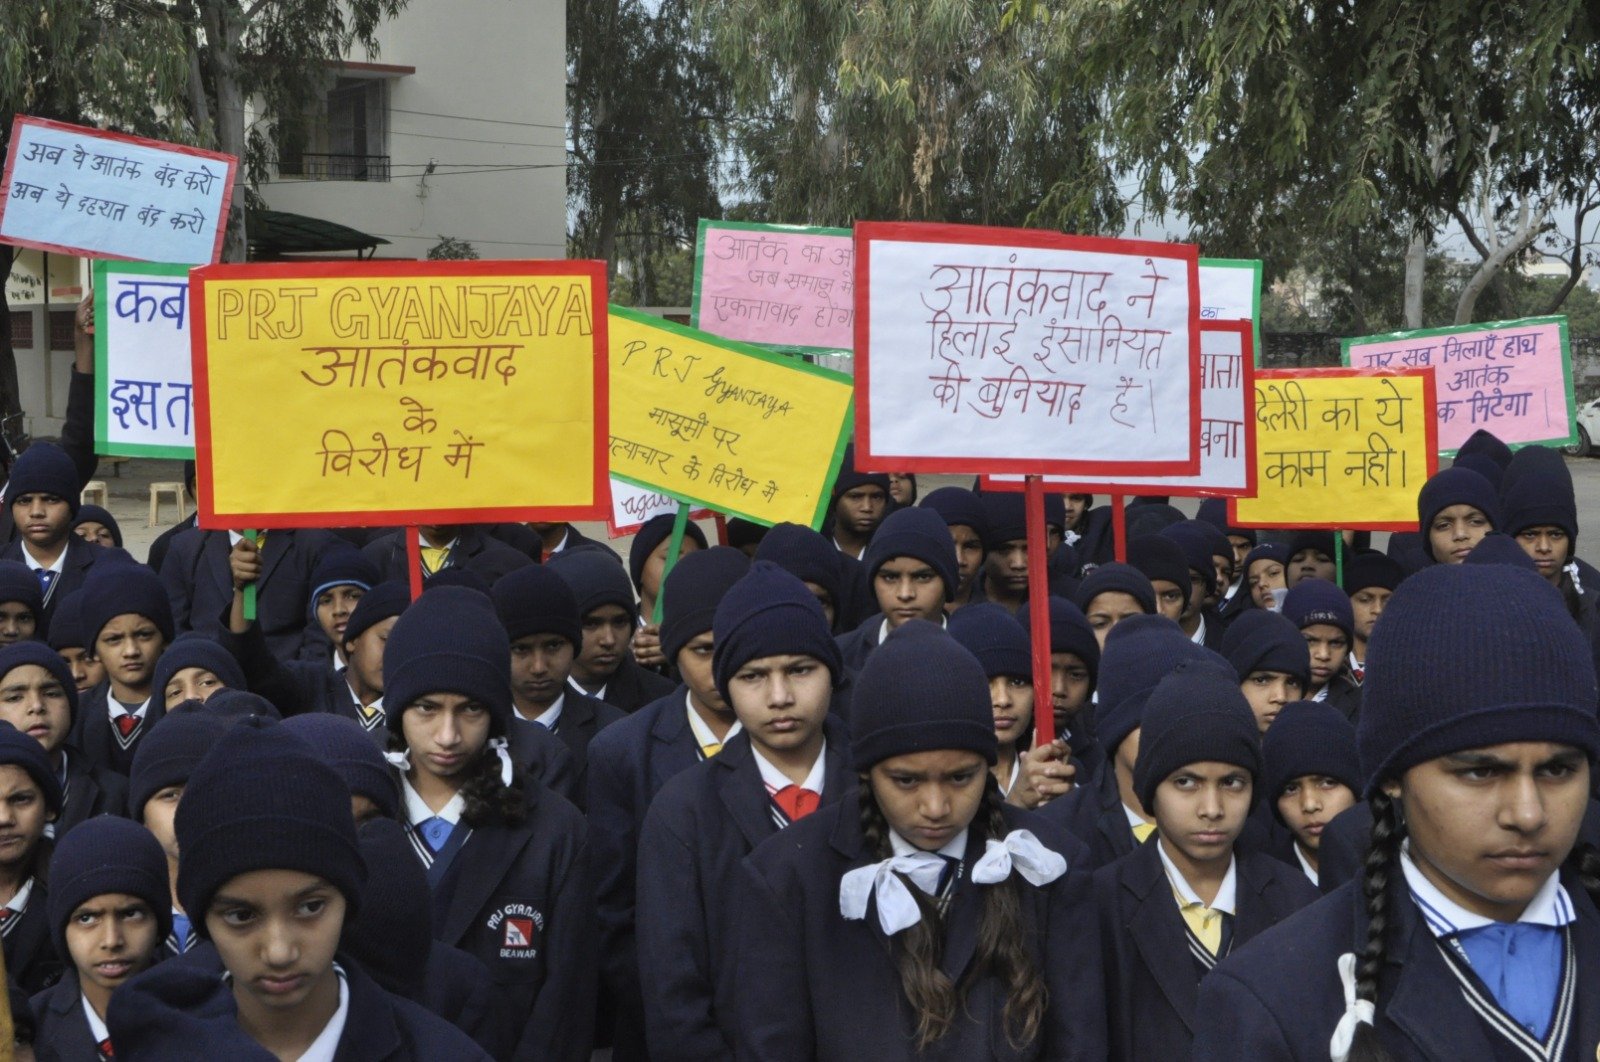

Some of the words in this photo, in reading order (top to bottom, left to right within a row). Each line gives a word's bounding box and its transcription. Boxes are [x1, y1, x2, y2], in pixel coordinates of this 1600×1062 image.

[23, 142, 67, 165] अब
[72, 144, 89, 170] ये
[91, 154, 144, 180] आतंक
[154, 163, 183, 188] बंद
[183, 165, 220, 195] करो
[11, 181, 48, 203] अब
[55, 183, 74, 209] ये
[78, 196, 129, 222] दहशत
[137, 204, 166, 228] बंद
[170, 208, 206, 234] करो
[712, 235, 788, 265] आतंक
[801, 244, 825, 264] का
[115, 280, 189, 330] कब
[748, 269, 779, 288] जब
[784, 273, 835, 293] समाज
[920, 253, 1114, 325] आतंकवाद
[1127, 258, 1169, 319] ने
[217, 287, 318, 340] PRJ
[330, 284, 593, 340] GYANJAYA
[710, 295, 803, 327] एकतावाद
[301, 340, 525, 388] आतंकवाद
[926, 308, 1027, 364] हिलाई
[1033, 315, 1172, 374] इंसानियत
[1402, 346, 1437, 366] सब
[1502, 332, 1544, 358] हाथ
[928, 361, 971, 413] की
[966, 365, 1086, 424] बुनियाद
[1446, 364, 1515, 391] आतंक
[110, 379, 161, 430] इस
[400, 396, 437, 435] के
[1322, 398, 1363, 432] का
[1375, 378, 1413, 433] ये
[316, 429, 431, 482] विरोध
[443, 430, 485, 478] में
[609, 435, 675, 475] त्याचार
[683, 455, 702, 481] के
[708, 463, 759, 496] विरोध
[712, 426, 741, 455] पर
[1264, 450, 1331, 488] काम
[500, 948, 537, 958] BEAWAR
